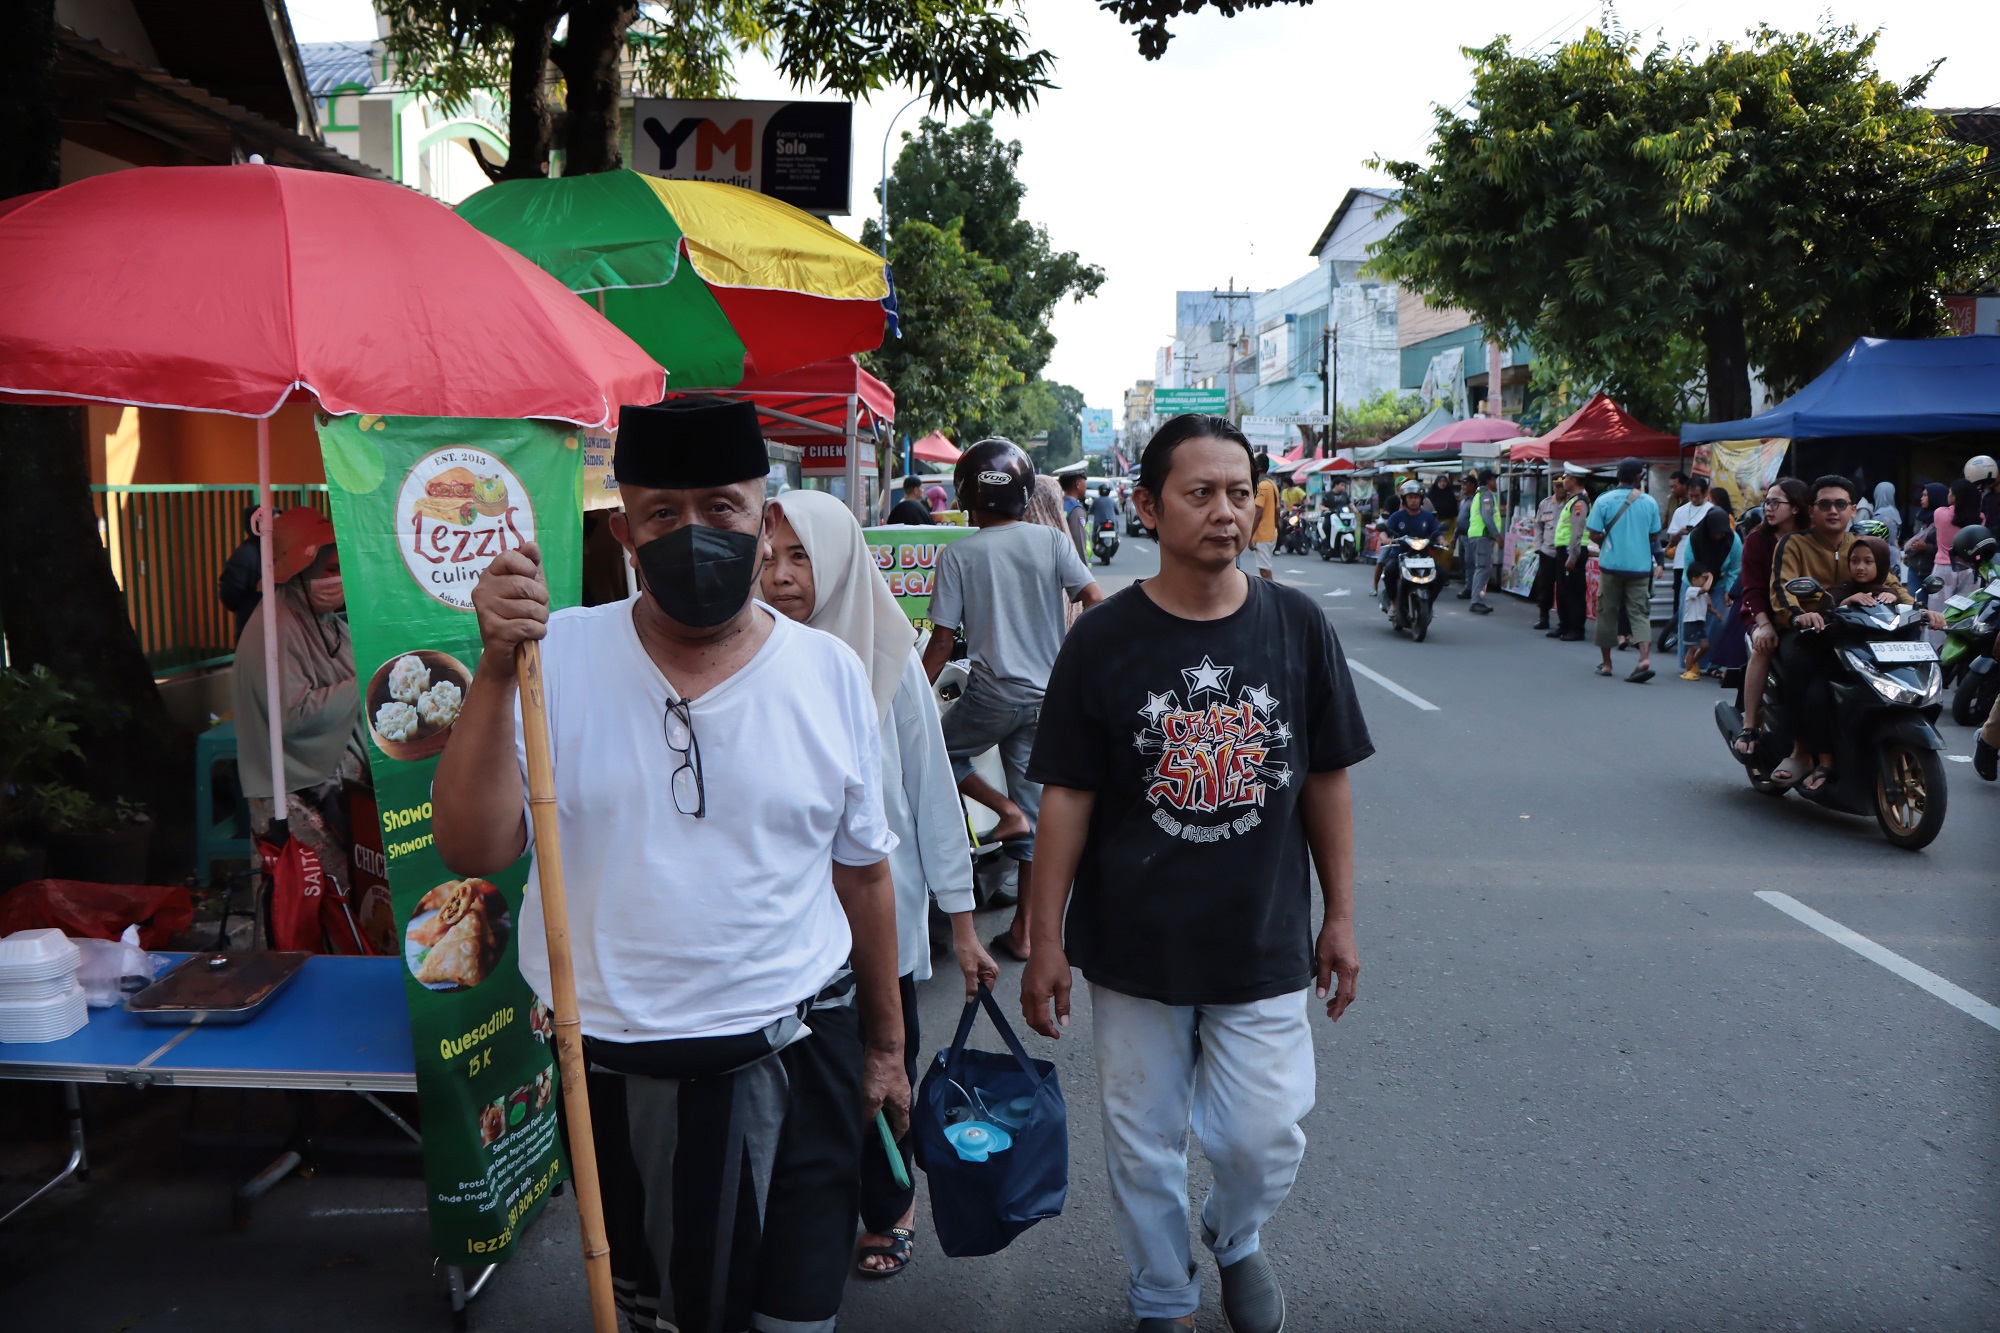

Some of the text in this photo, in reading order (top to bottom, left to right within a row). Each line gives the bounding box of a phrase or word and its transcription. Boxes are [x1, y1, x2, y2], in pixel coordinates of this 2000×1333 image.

[643, 117, 753, 172] YM
[776, 138, 807, 155] Solo
[694, 174, 752, 188] Mdiri
[584, 434, 611, 449] hawarma
[434, 453, 486, 466] EST. 2015
[899, 544, 947, 569] BUA
[431, 566, 486, 583] culin
[881, 571, 936, 596] EGA
[438, 592, 475, 608] Asia's Aut
[1872, 644, 1886, 652] AD
[1887, 644, 1912, 652] 3062
[1146, 741, 1270, 814] SALE
[382, 802, 432, 833] Shawa
[1151, 808, 1262, 843] SOLO THRIFT DAY
[440, 1006, 514, 1060] Quesadilla
[468, 1046, 492, 1078] 15 K
[492, 1137, 510, 1155] Sedia
[510, 1124, 531, 1143] Frozen
[438, 1193, 462, 1203] Onde
[505, 1187, 520, 1208] more
[518, 1190, 533, 1216] 804
[534, 1174, 548, 1199] 555
